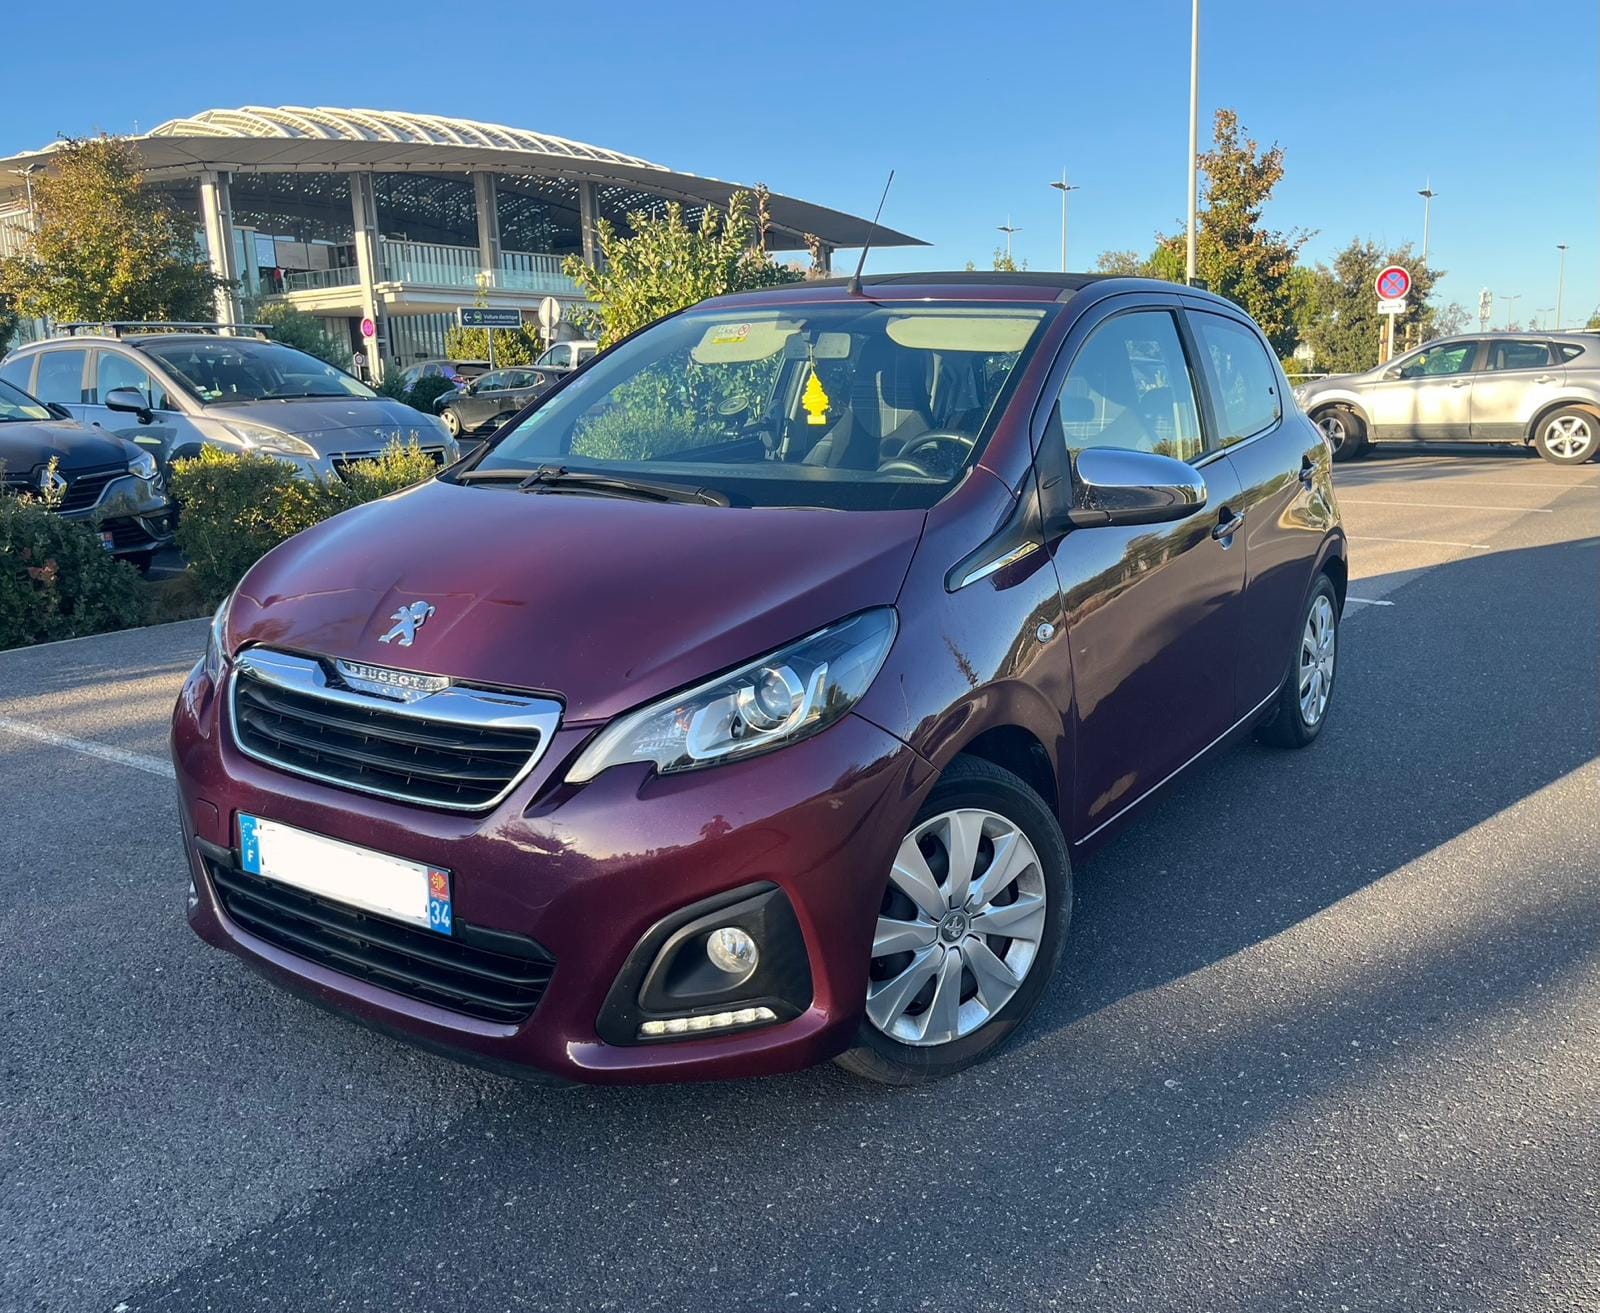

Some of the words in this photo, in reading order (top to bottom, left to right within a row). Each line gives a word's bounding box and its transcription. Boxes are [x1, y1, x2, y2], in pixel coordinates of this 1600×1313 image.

[350, 665, 419, 687] PEUGEOT
[248, 848, 255, 862] F
[431, 900, 450, 928] 34
